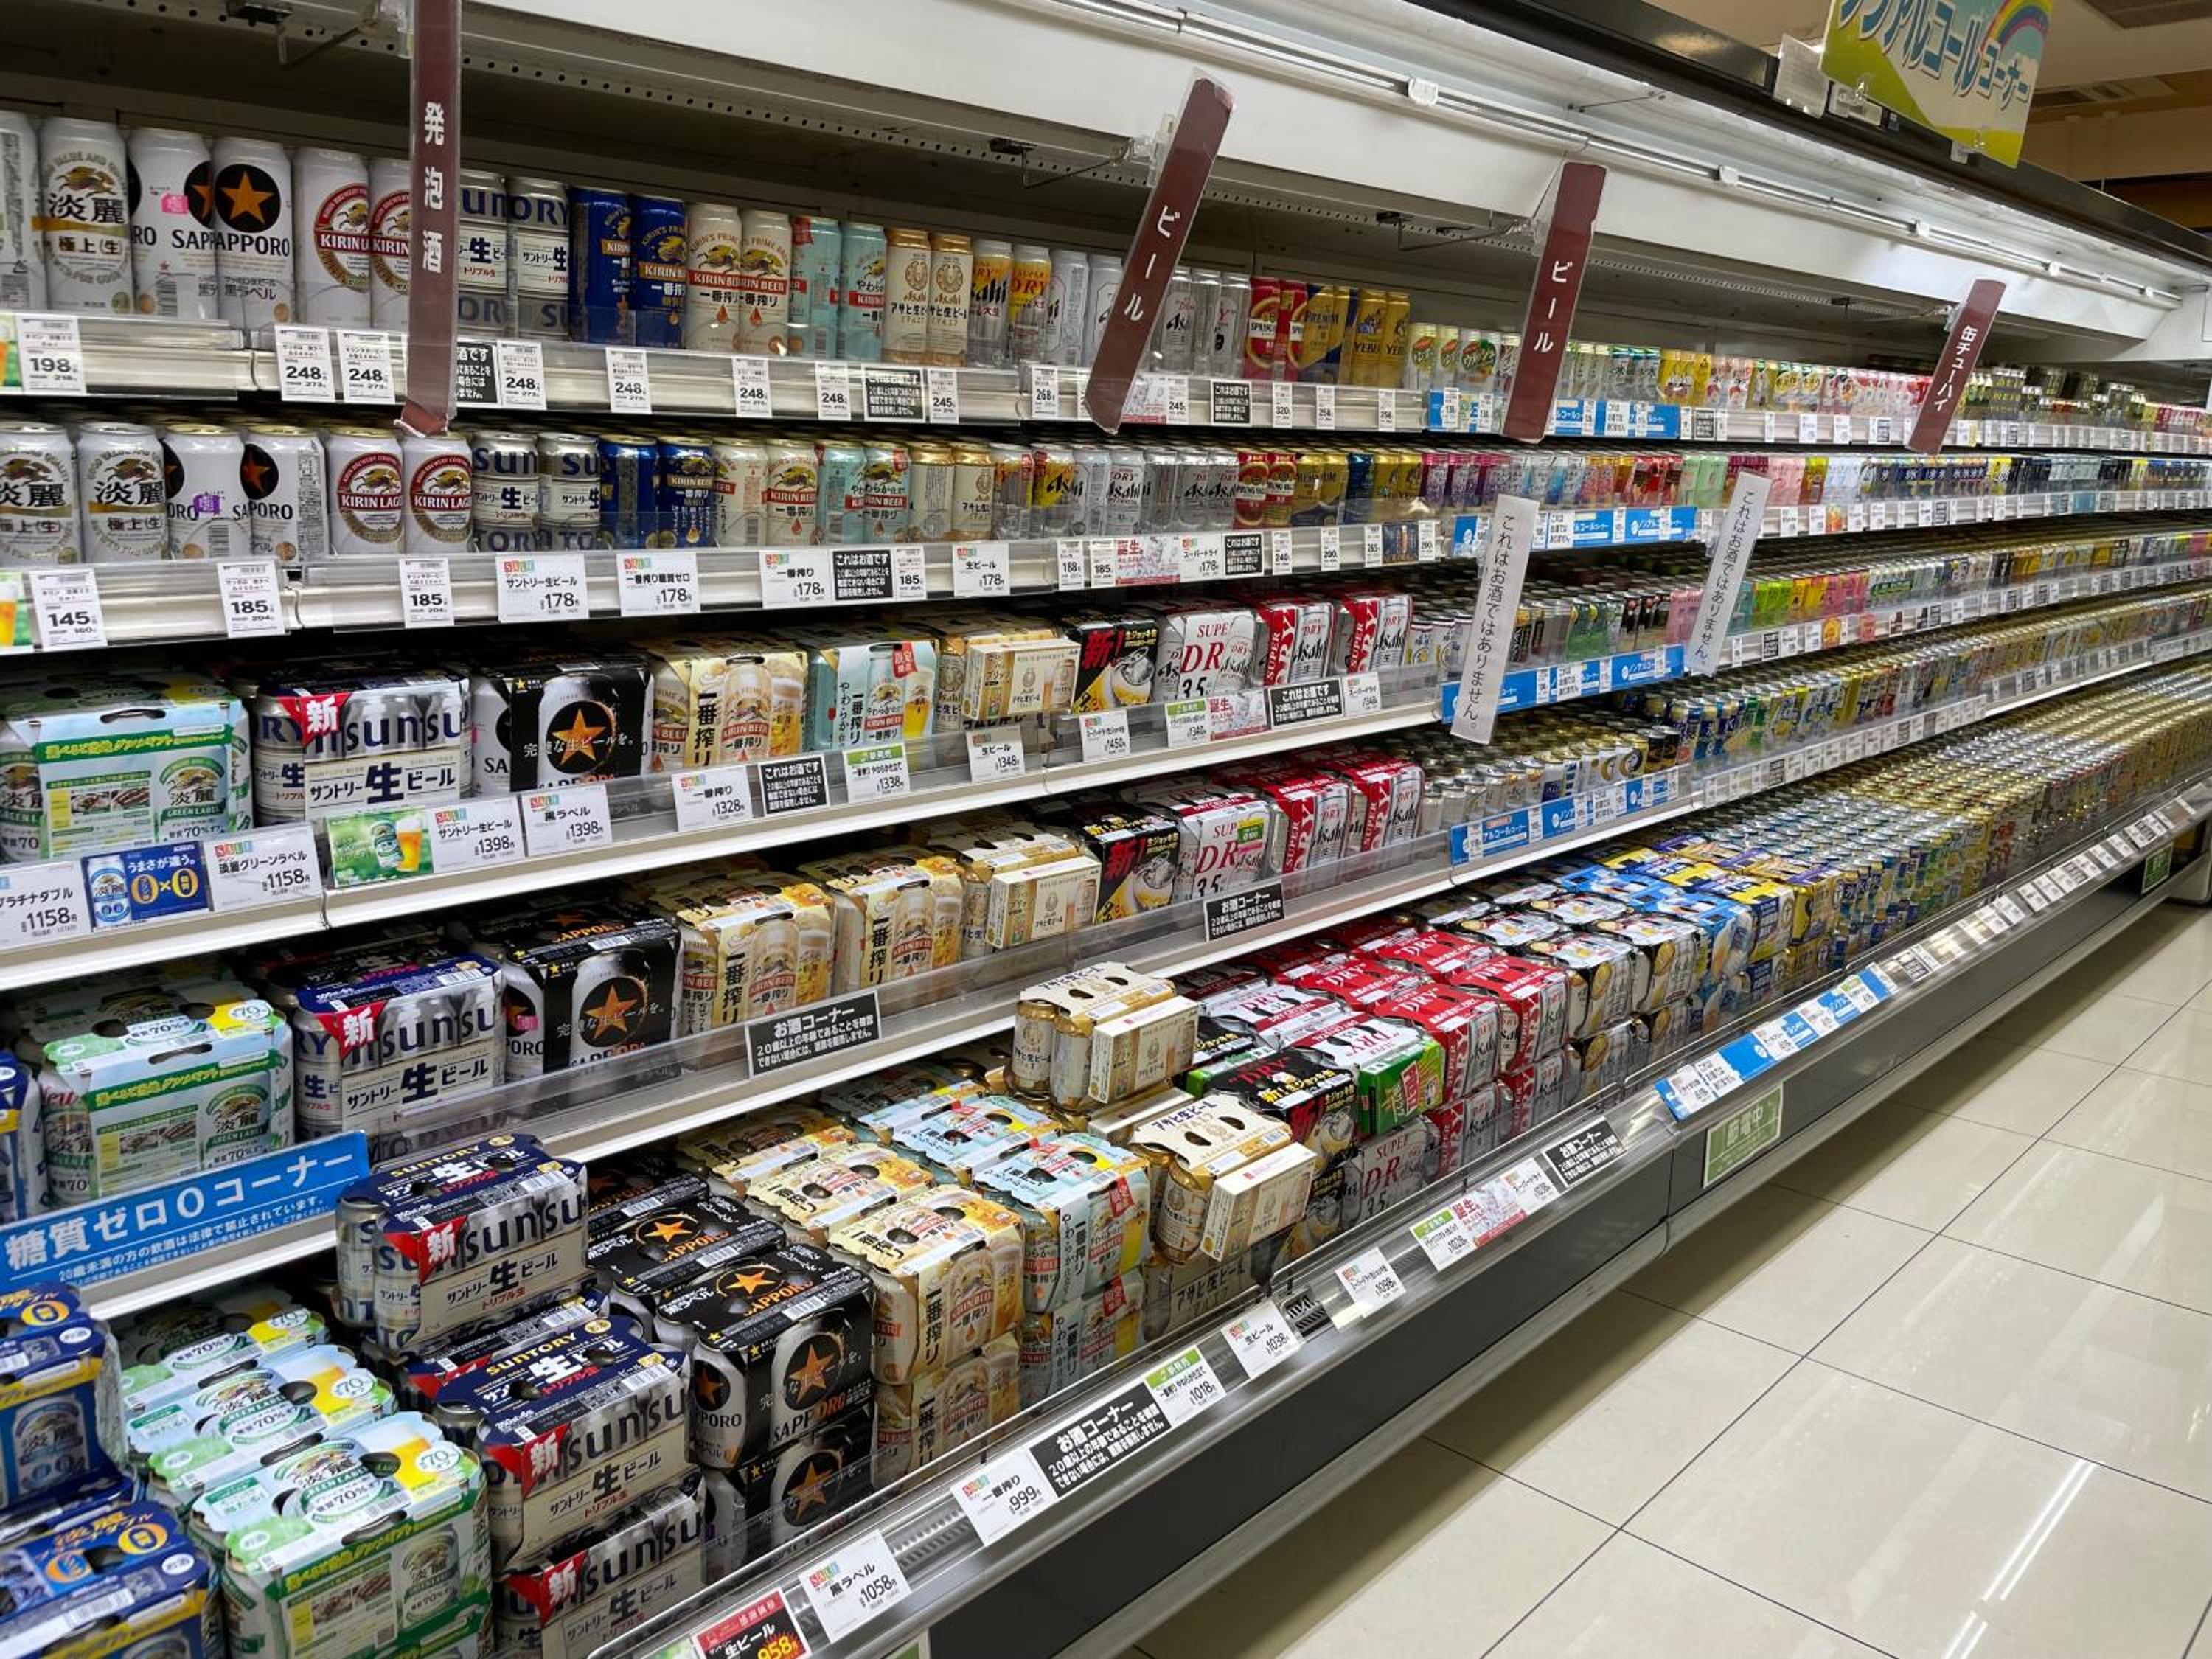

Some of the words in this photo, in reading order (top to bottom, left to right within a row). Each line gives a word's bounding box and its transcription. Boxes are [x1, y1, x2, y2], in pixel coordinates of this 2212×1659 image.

[422, 102, 445, 274] 発泡酒
[47, 192, 125, 225] 淡麗
[1124, 205, 1180, 321] ビール
[1533, 260, 1573, 353] ビール
[30, 357, 72, 373] 198
[285, 365, 322, 380] 248
[349, 368, 383, 382] 248
[1934, 324, 1979, 411] 缶チューハイ
[505, 376, 535, 390] 248
[614, 382, 641, 394] 248
[740, 388, 764, 399] 248
[821, 392, 844, 404] 248
[932, 397, 953, 408] 245
[341, 495, 378, 508] KIRIN
[414, 495, 450, 508] KIRIN
[770, 492, 799, 503] KIRIN
[776, 567, 815, 578] 一番搾り
[965, 560, 997, 570] 生ビール
[506, 577, 577, 588] サントリー生ビール
[899, 574, 920, 585] 185
[231, 599, 268, 614] 185
[410, 593, 443, 607] 185
[49, 611, 90, 627] 145
[1463, 516, 1515, 729] これはお酒ではありません。
[305, 697, 338, 734] 新
[764, 761, 820, 779] これはお酒です
[309, 762, 456, 804] サントリー生ビール
[692, 785, 733, 799] 一番搾り
[544, 807, 591, 822] 黒ラベル
[437, 818, 512, 839] サントリー生ビール
[127, 854, 197, 873] うまさが違う。
[218, 851, 307, 874] 淡麗グリーンラベル
[341, 1008, 375, 1048] 新
[773, 1006, 855, 1038] お酒コーナー
[346, 1057, 489, 1110] サントリー生ビール
[426, 1223, 456, 1263] 新
[446, 1251, 559, 1304] サントリー生ビール
[1244, 1323, 1275, 1346] 生ビール
[1055, 1399, 1135, 1454] お酒コーナー
[529, 1435, 561, 1477] 新
[549, 1448, 662, 1515] サントリー生ビール
[981, 1473, 1021, 1502] 一番搾り
[829, 1562, 877, 1598] 黒ラベル
[724, 1622, 776, 1659] 生ビール
